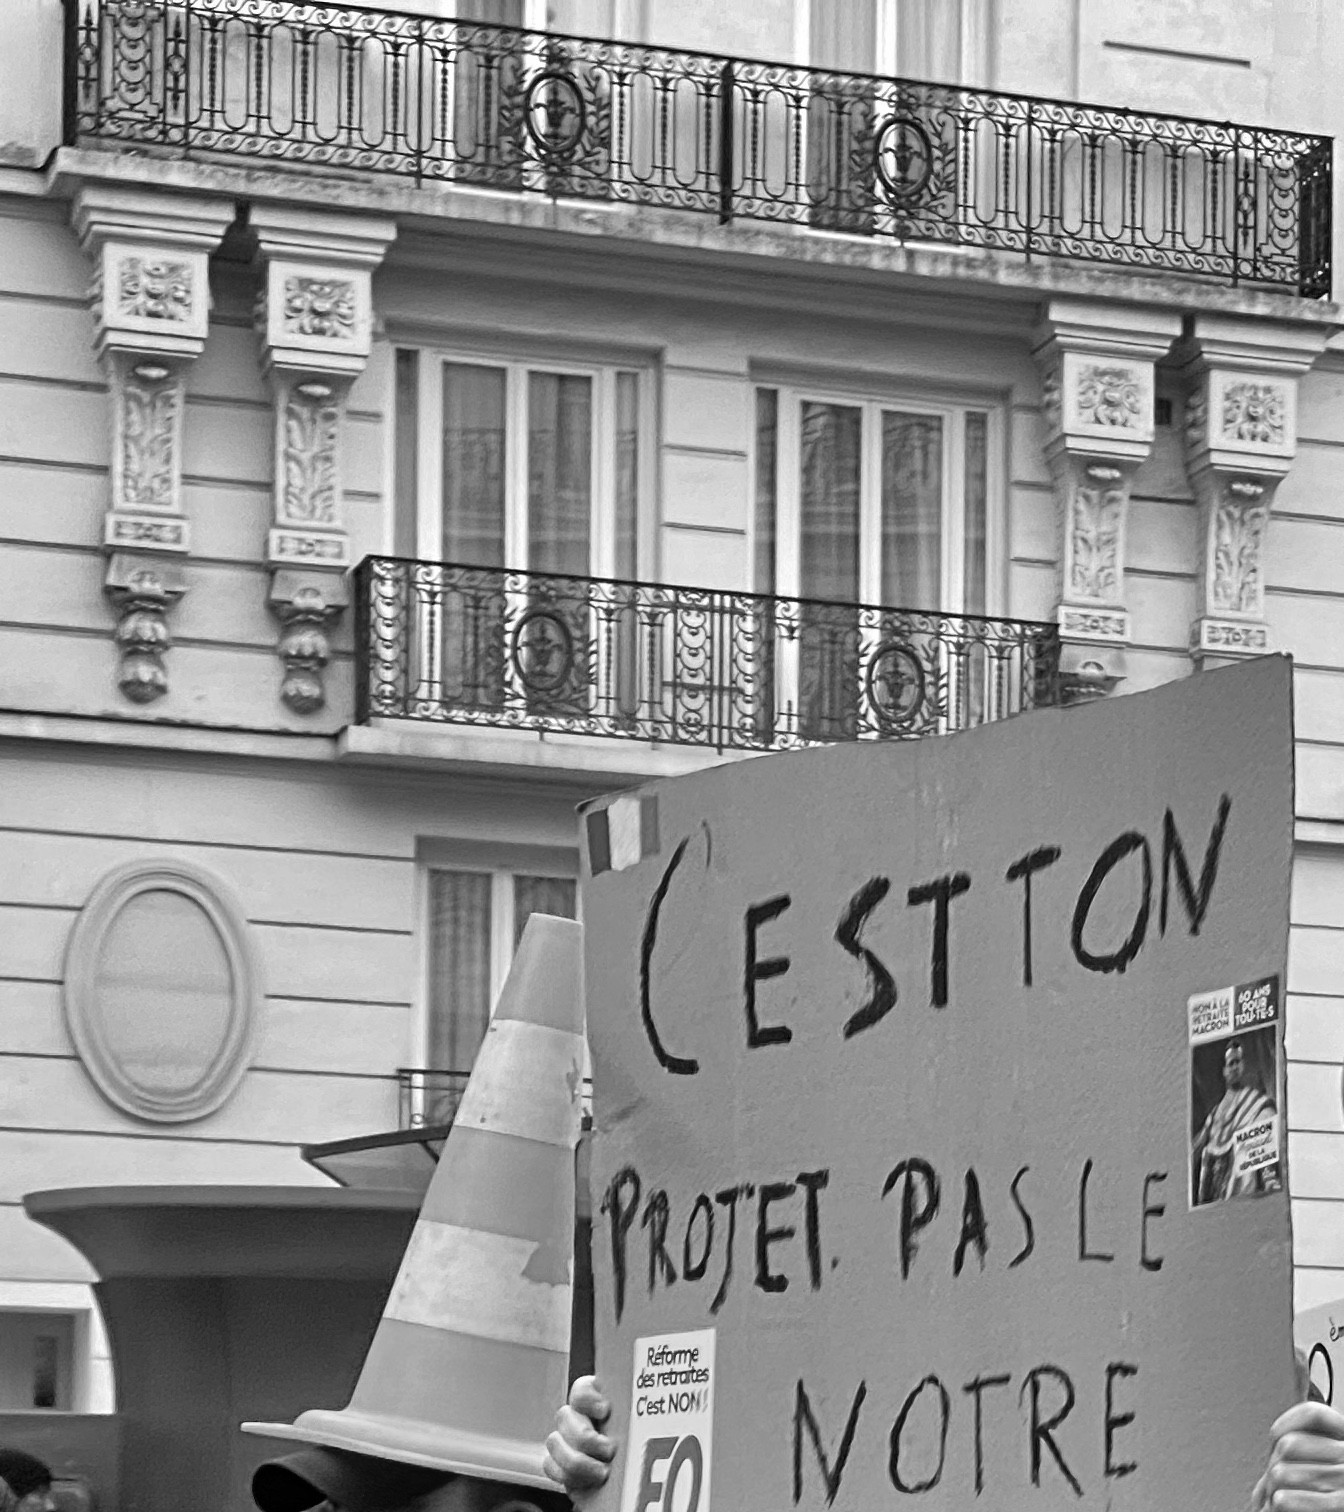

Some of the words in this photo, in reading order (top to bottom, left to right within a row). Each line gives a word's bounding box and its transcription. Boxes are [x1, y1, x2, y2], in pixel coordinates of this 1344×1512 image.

[1004, 793, 1232, 989] TON
[1236, 1121, 1272, 1142] MACRON
[882, 1156, 1035, 1281] PAS
[1077, 1157, 1170, 1272] LE
[647, 1343, 699, 1367] Réforme
[636, 1370, 656, 1389] des
[657, 1366, 710, 1386] retraites
[636, 1395, 666, 1416] C'est
[793, 1364, 1140, 1506] NOTRE
